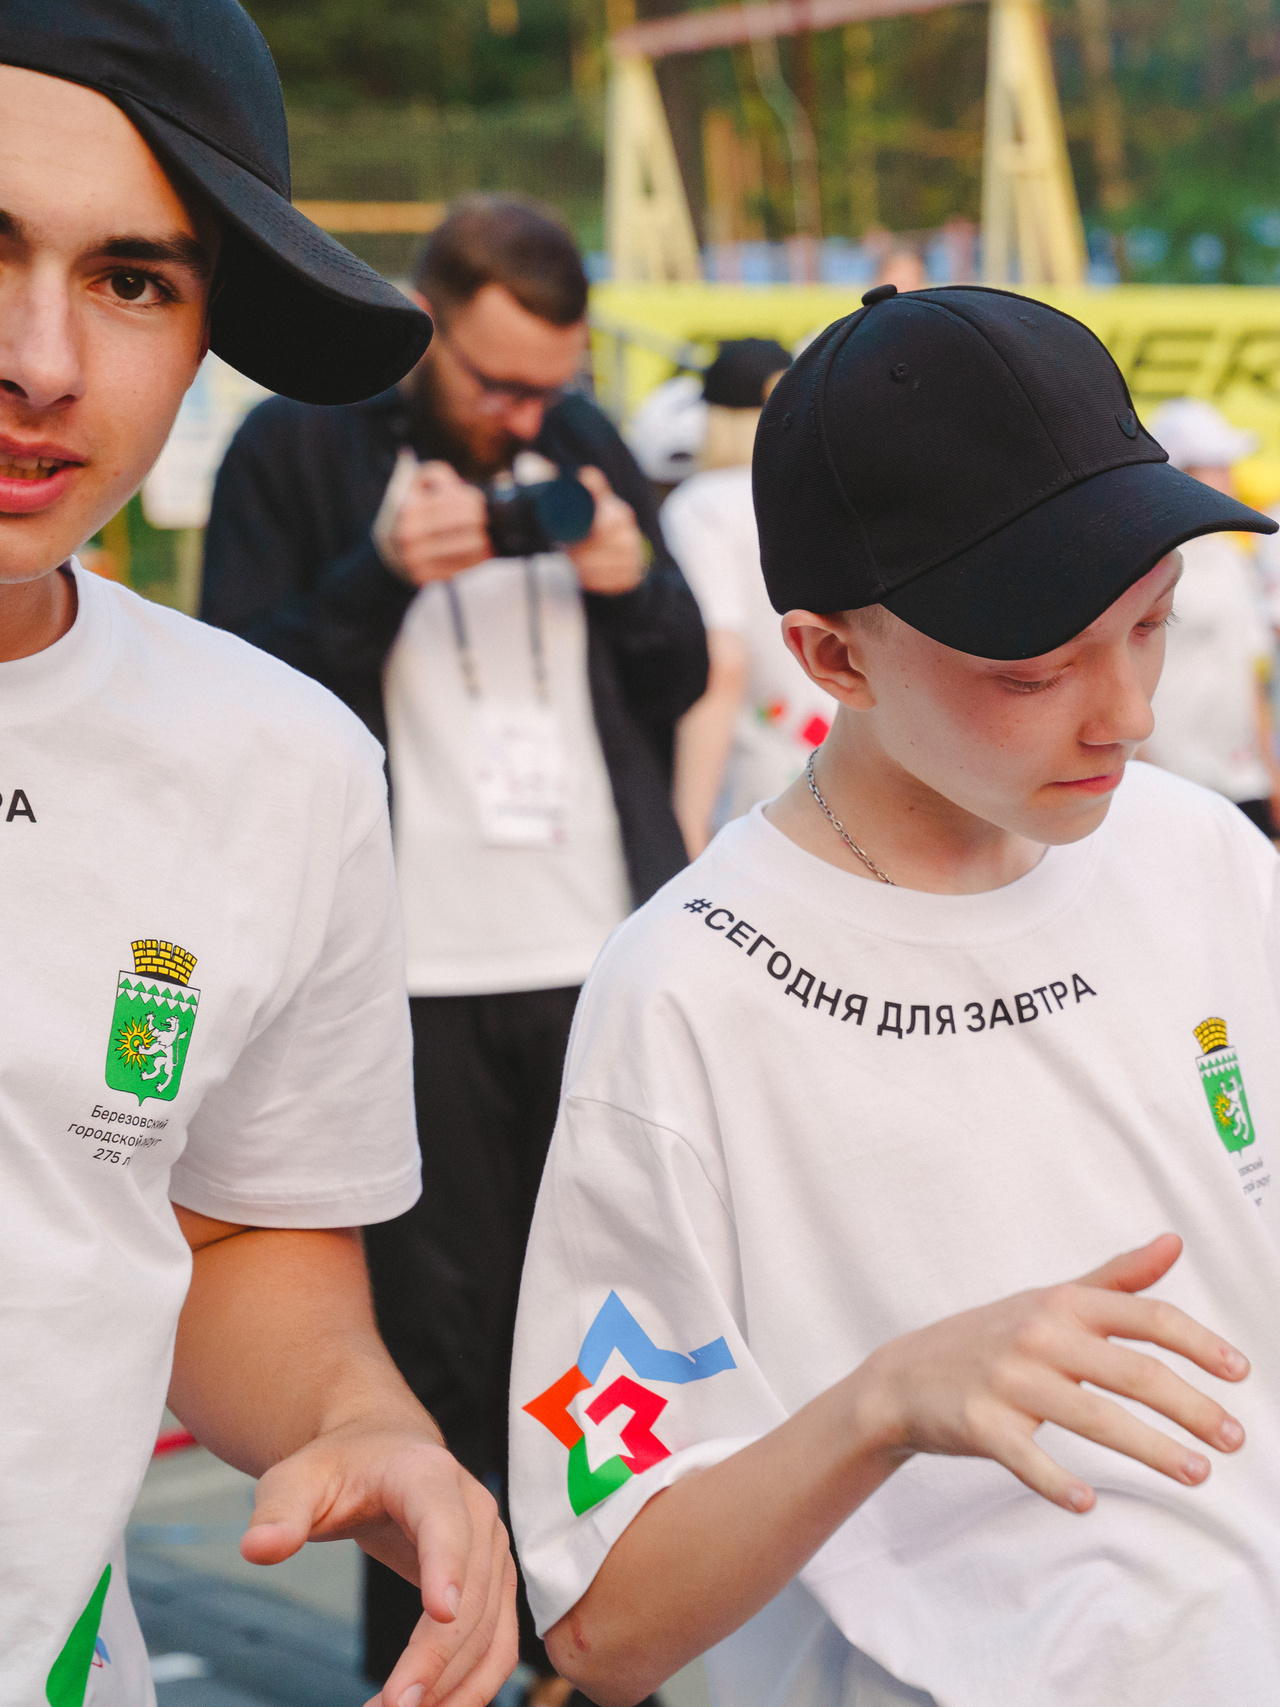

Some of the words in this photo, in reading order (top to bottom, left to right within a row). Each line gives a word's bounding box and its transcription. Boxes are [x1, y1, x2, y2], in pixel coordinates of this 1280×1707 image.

[0, 788, 37, 823] А
[683, 898, 868, 1026] #СЕГОДНЯ
[876, 1001, 956, 1040] ДЛЯ
[963, 972, 1098, 1033] ЗАВТРА
[90, 1104, 169, 1130] Березовский
[67, 1123, 143, 1147] городской
[92, 1147, 122, 1164] 275
